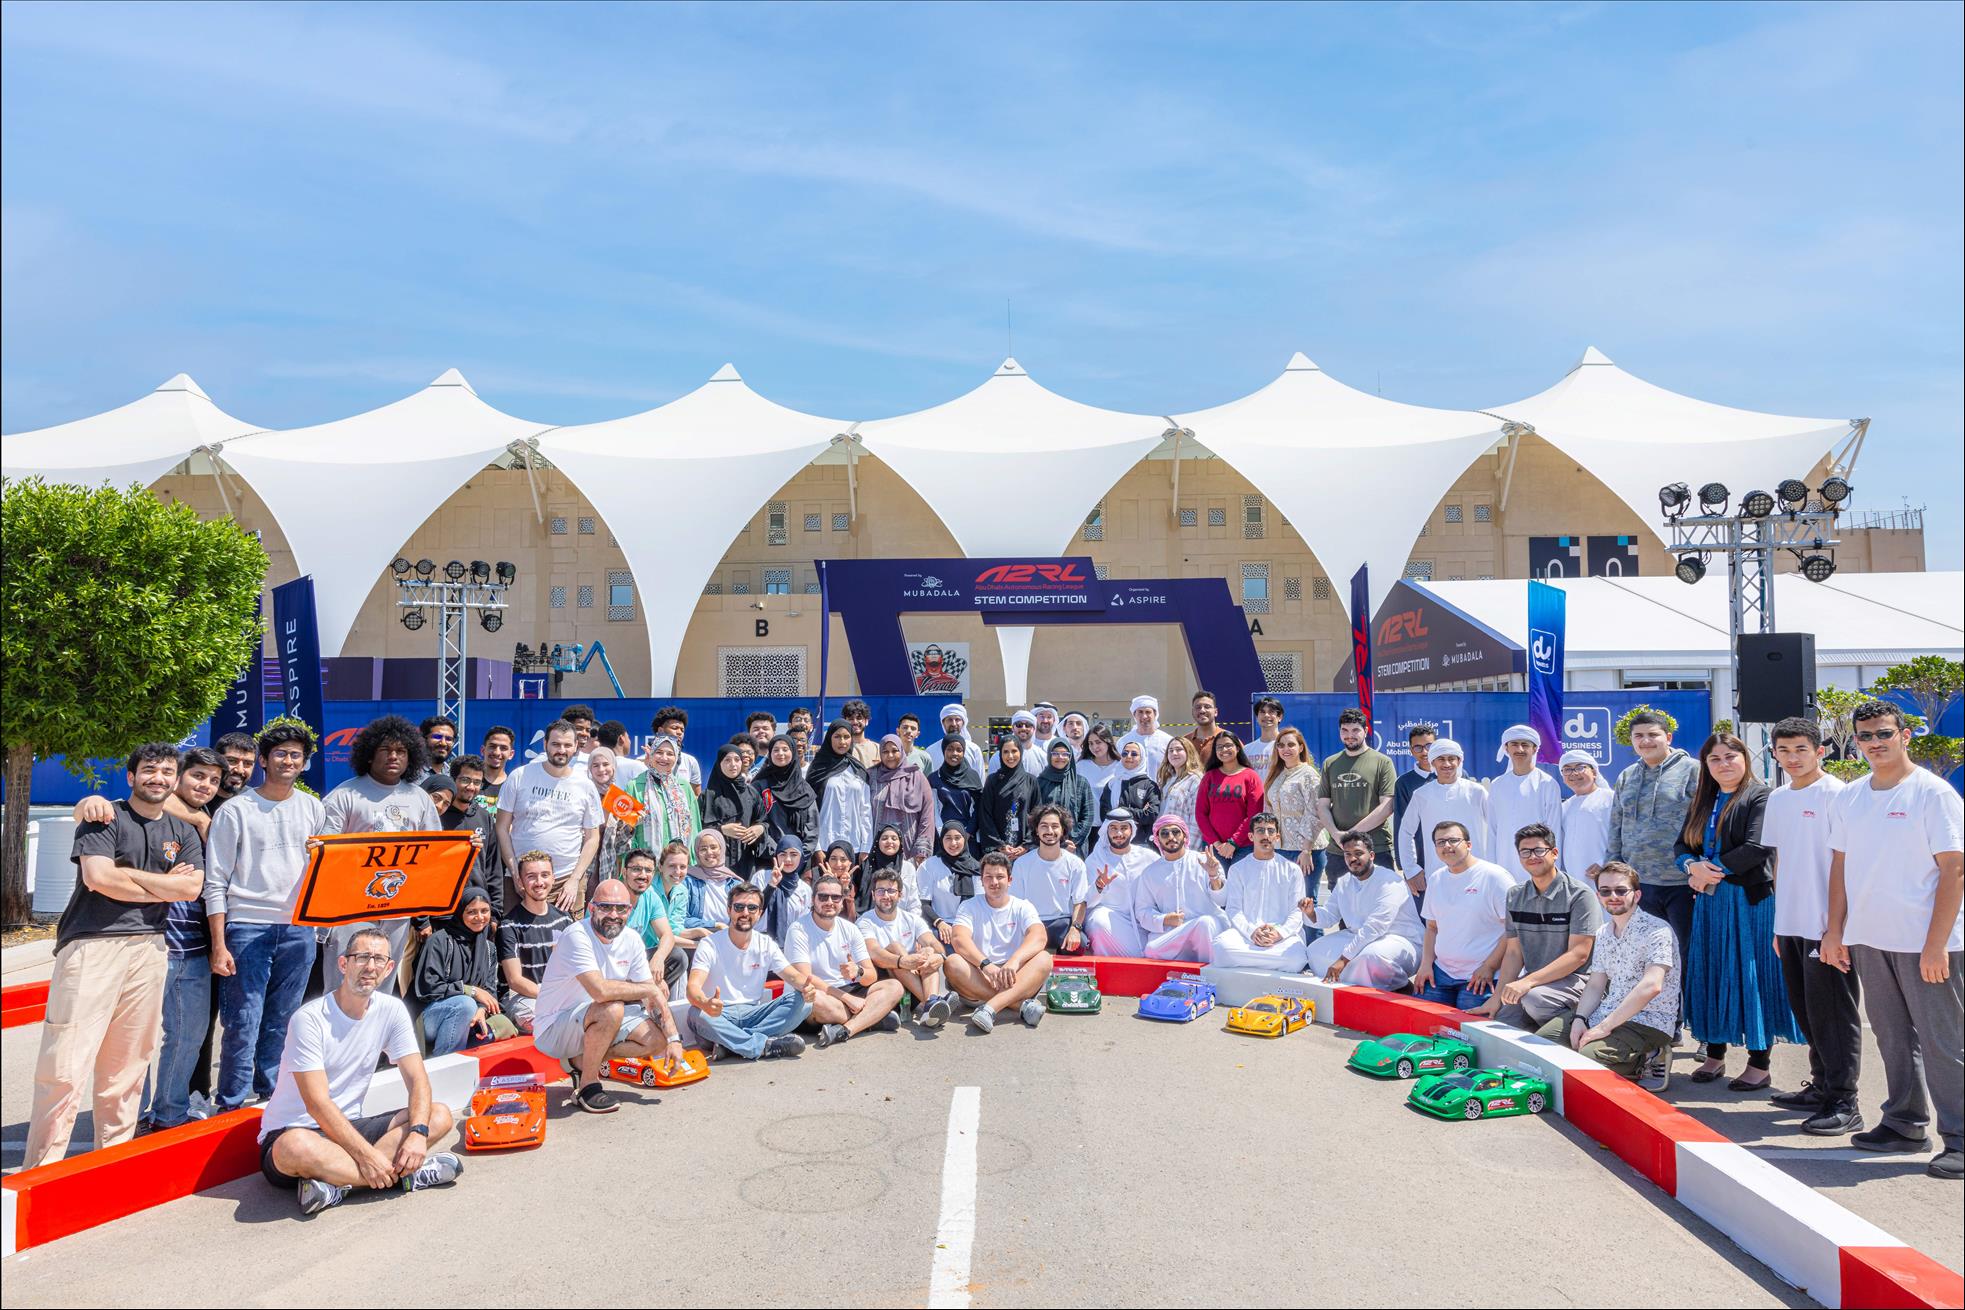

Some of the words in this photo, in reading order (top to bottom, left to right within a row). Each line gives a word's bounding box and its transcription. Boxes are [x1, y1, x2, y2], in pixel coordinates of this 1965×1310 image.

[974, 596, 1007, 605] STEM
[1008, 595, 1088, 604] COMPETITION
[1128, 596, 1167, 604] ASPIRE
[755, 619, 769, 637] B
[1250, 618, 1264, 636] A
[1451, 649, 1484, 665] MUBADALA
[286, 618, 303, 720] ASPIRE
[1377, 663, 1392, 678] STEM
[1392, 657, 1430, 675] COMPETITION
[1386, 740, 1401, 749] Abu
[1562, 742, 1602, 750] BUSINESS
[531, 785, 573, 801] COFFEE
[360, 843, 430, 868] RIT
